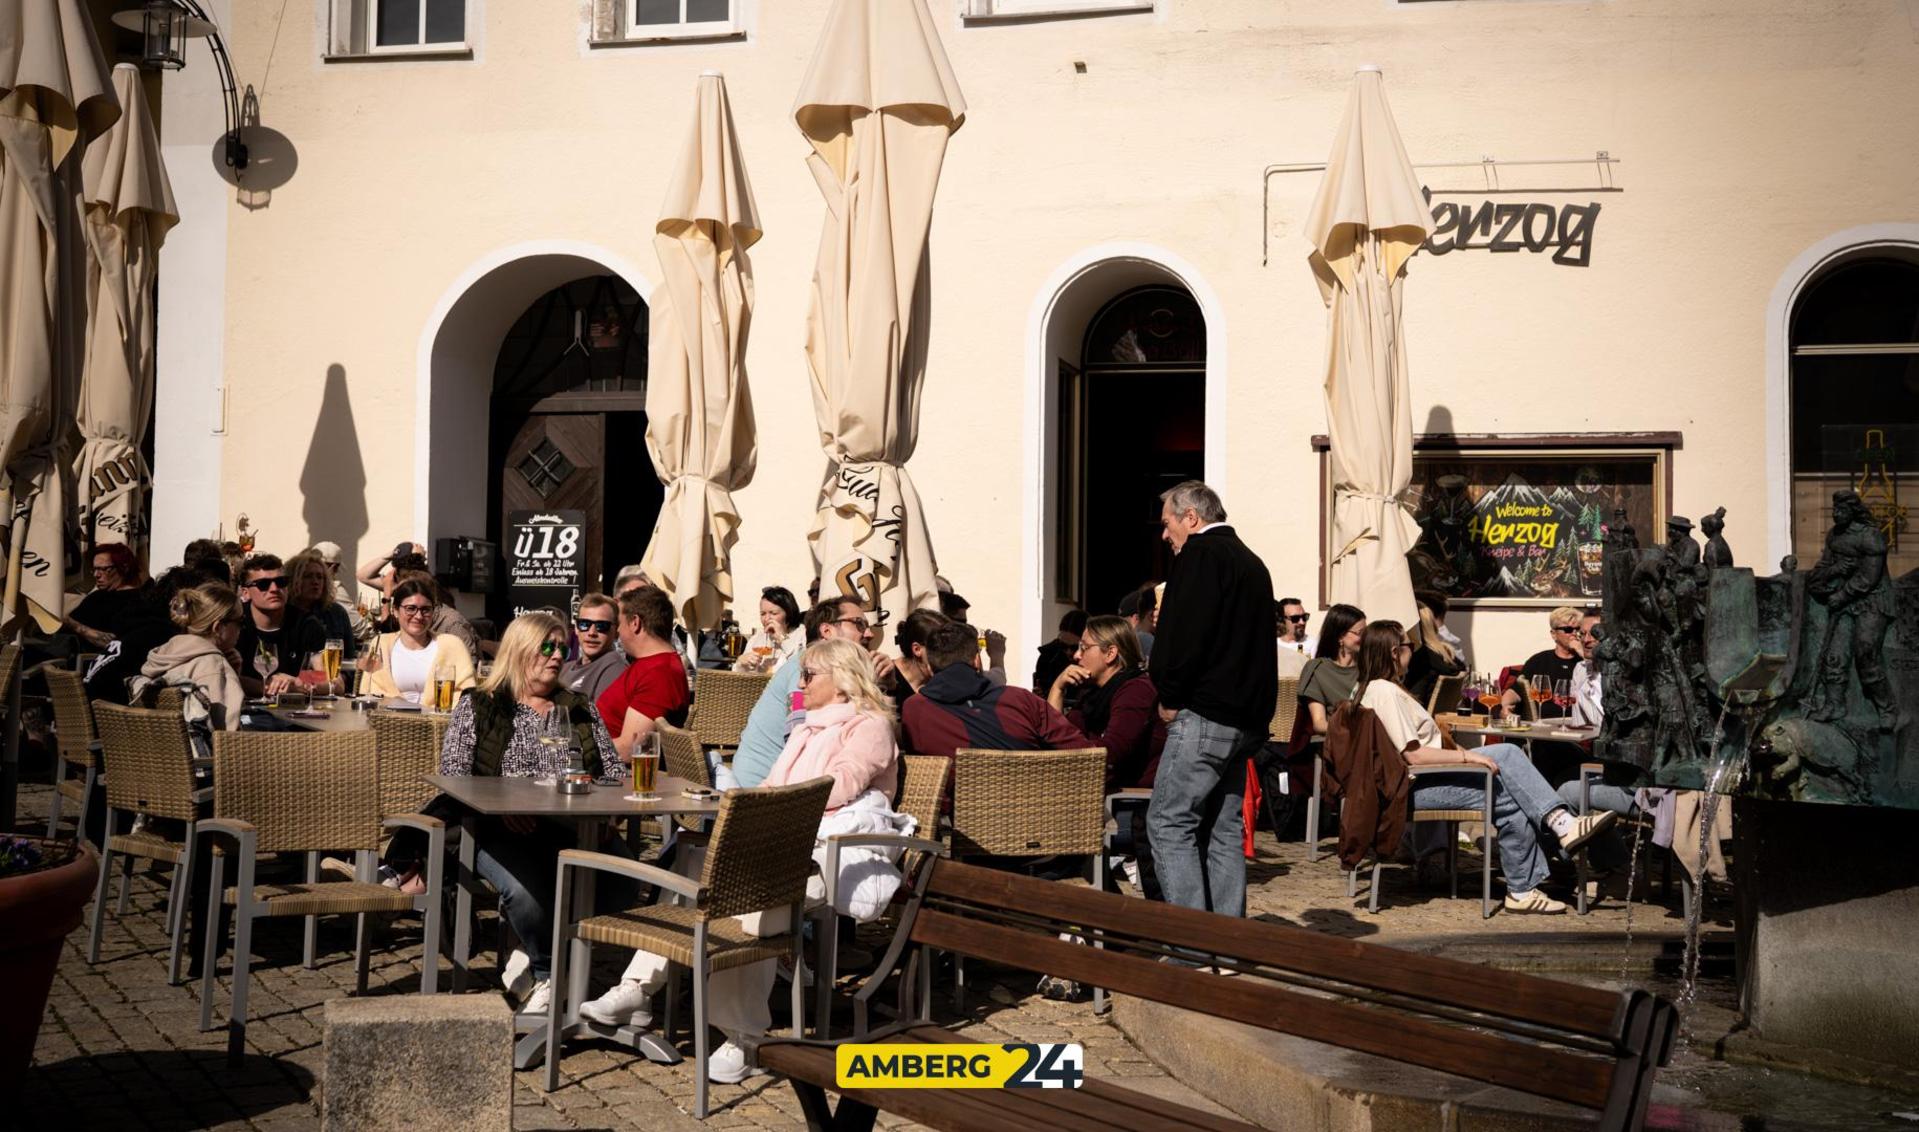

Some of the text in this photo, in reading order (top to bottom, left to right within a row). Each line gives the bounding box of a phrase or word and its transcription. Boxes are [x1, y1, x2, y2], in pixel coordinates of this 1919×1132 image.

[1420, 187, 1602, 267] erzog
[1495, 502, 1553, 518] Welcome to
[514, 526, 580, 559] ü18
[1467, 513, 1560, 549] Herzog
[1516, 545, 1525, 557] &
